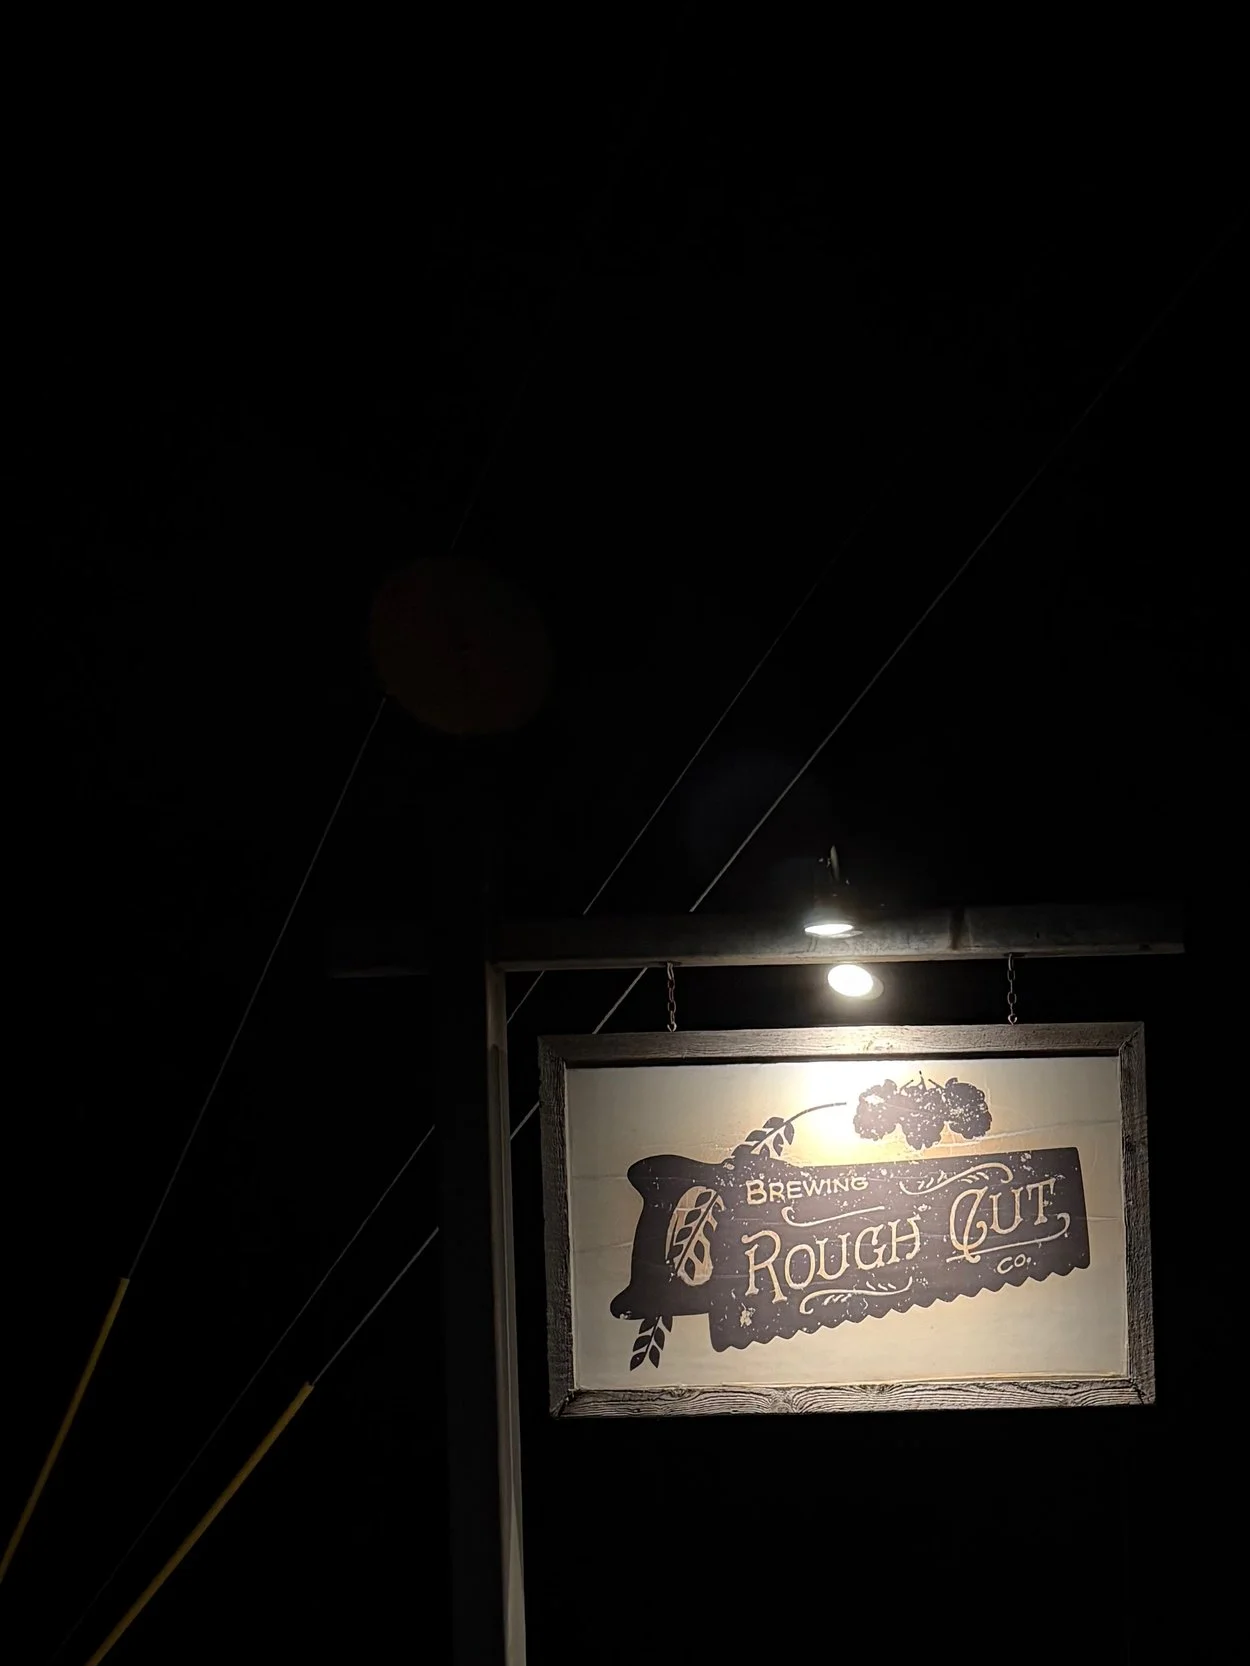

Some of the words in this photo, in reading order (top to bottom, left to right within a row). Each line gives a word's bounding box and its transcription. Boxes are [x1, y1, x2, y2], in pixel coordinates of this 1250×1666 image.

[746, 1174, 869, 1205] BREWING
[741, 1215, 921, 1304] ROUGH
[949, 1178, 1057, 1264] CUT
